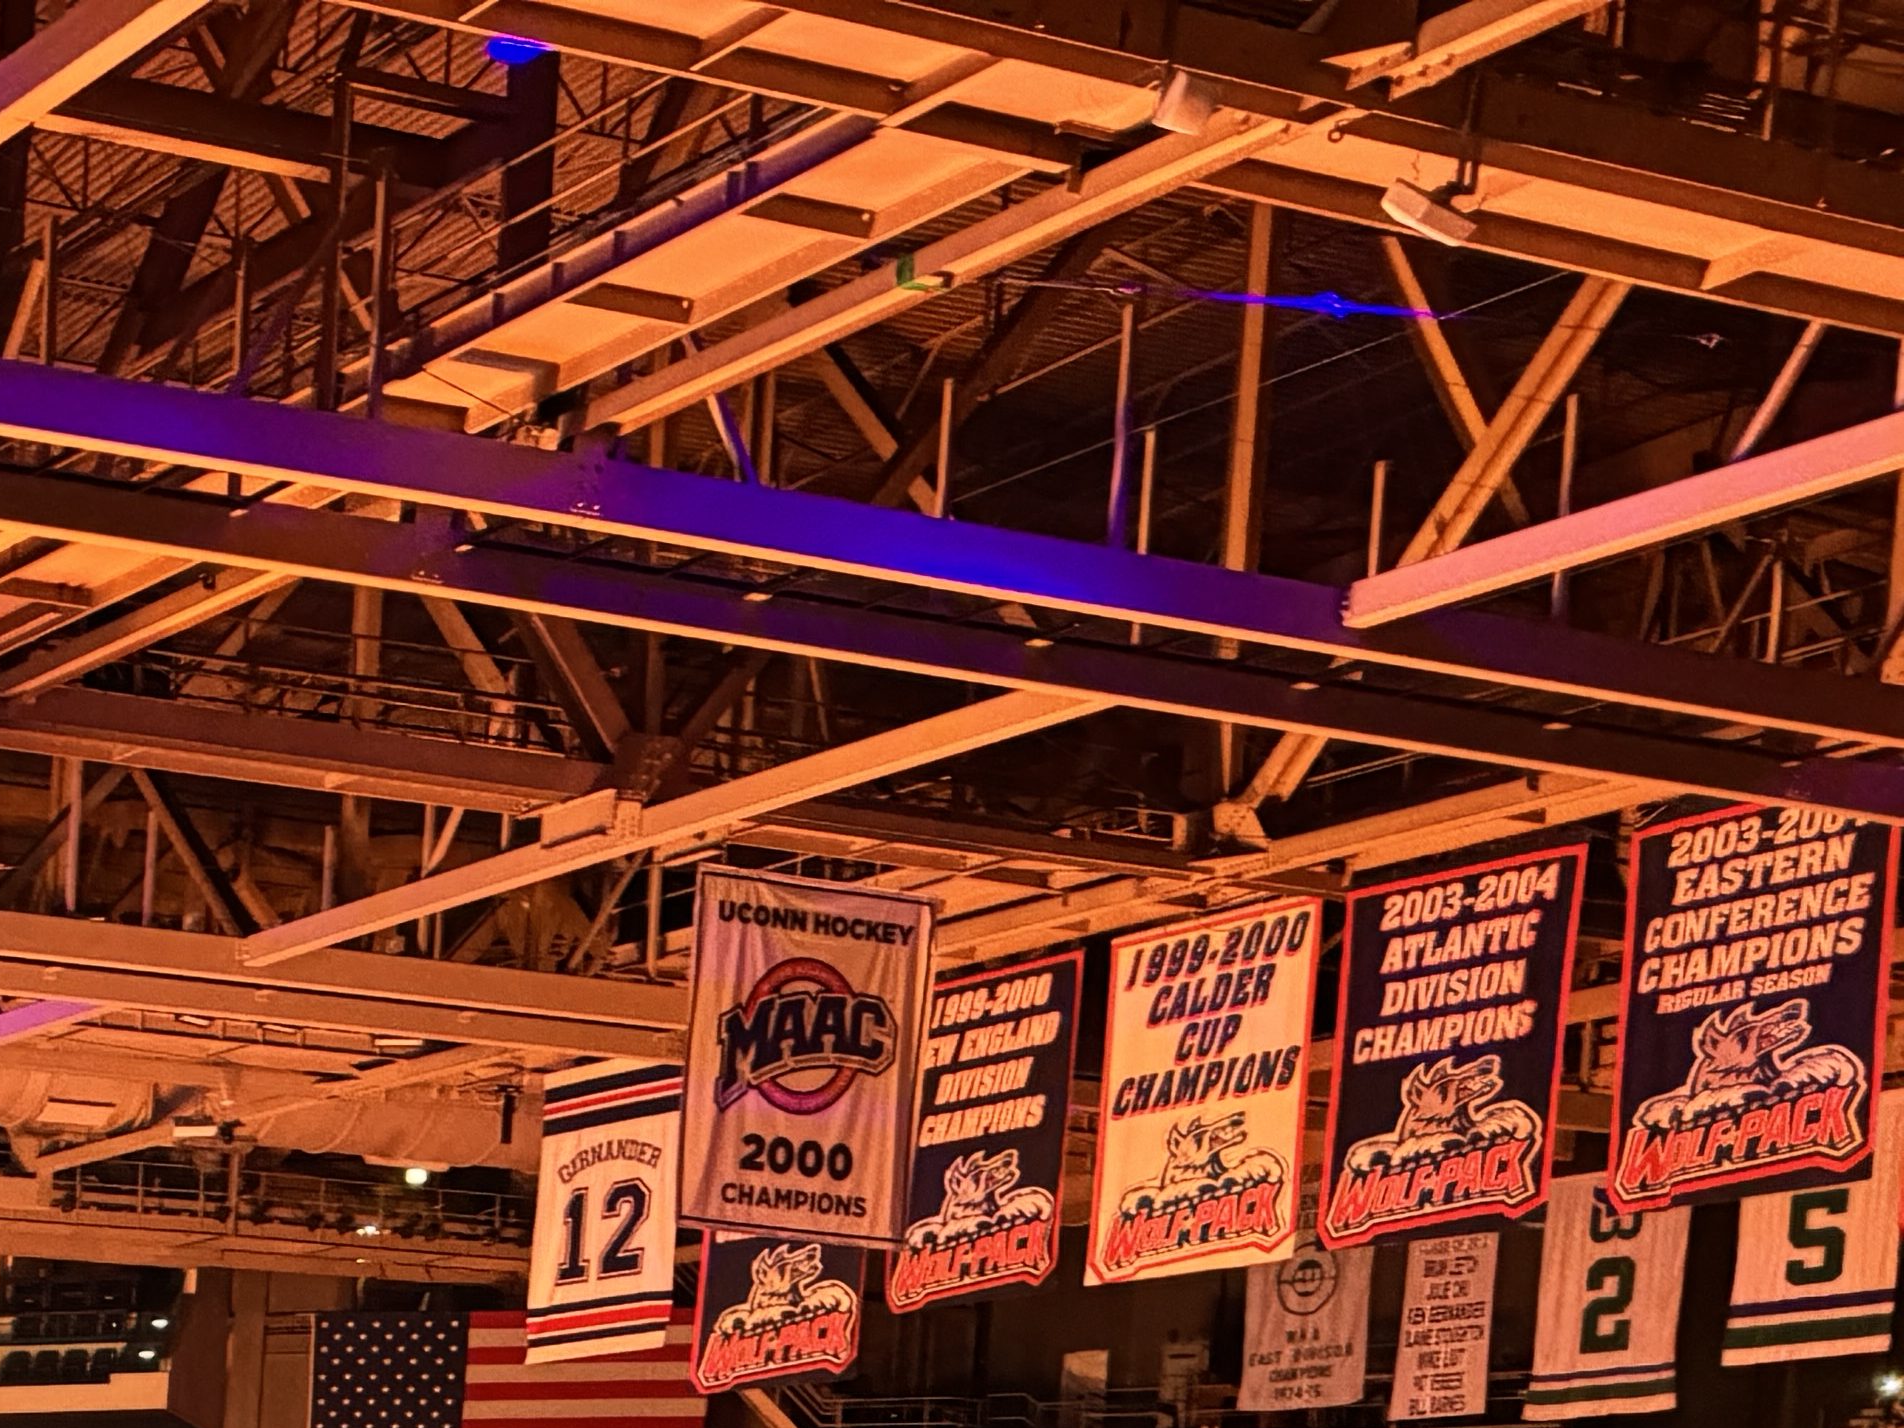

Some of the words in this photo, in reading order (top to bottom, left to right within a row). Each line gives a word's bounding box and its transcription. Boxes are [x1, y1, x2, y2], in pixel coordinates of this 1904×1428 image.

[1379, 863, 1560, 932] 2003-2004
[1672, 834, 1858, 906] EASTERN
[718, 900, 808, 931] UCONN
[812, 911, 914, 946] HOCKEY
[1379, 909, 1542, 974] ATLANTIC
[1644, 872, 1876, 954] CONFERENCE
[1126, 913, 1309, 990] 1999-2000
[1638, 917, 1867, 994] CHAMPIONS
[1749, 963, 1833, 998] SEASON
[931, 973, 1054, 1028] 1999-2000
[1147, 964, 1277, 1028] CALDER
[1380, 958, 1529, 1017] DIVISION
[718, 992, 895, 1108] MAAC
[923, 1036, 960, 1068] EW
[962, 1011, 1062, 1061] ENGLAND
[1175, 1013, 1242, 1065] CUP
[1352, 1000, 1539, 1065] CHAMPIONS
[935, 1056, 1035, 1105] DIVISION
[1111, 1045, 1302, 1121] CHAMPIONS
[919, 1095, 1047, 1147] CHAMPIONS
[739, 1133, 853, 1181] 2000
[556, 1176, 652, 1285] 12
[721, 1182, 867, 1217] CHAMPIONS
[1785, 1188, 1850, 1286] 5
[1579, 1256, 1636, 1355] 2
